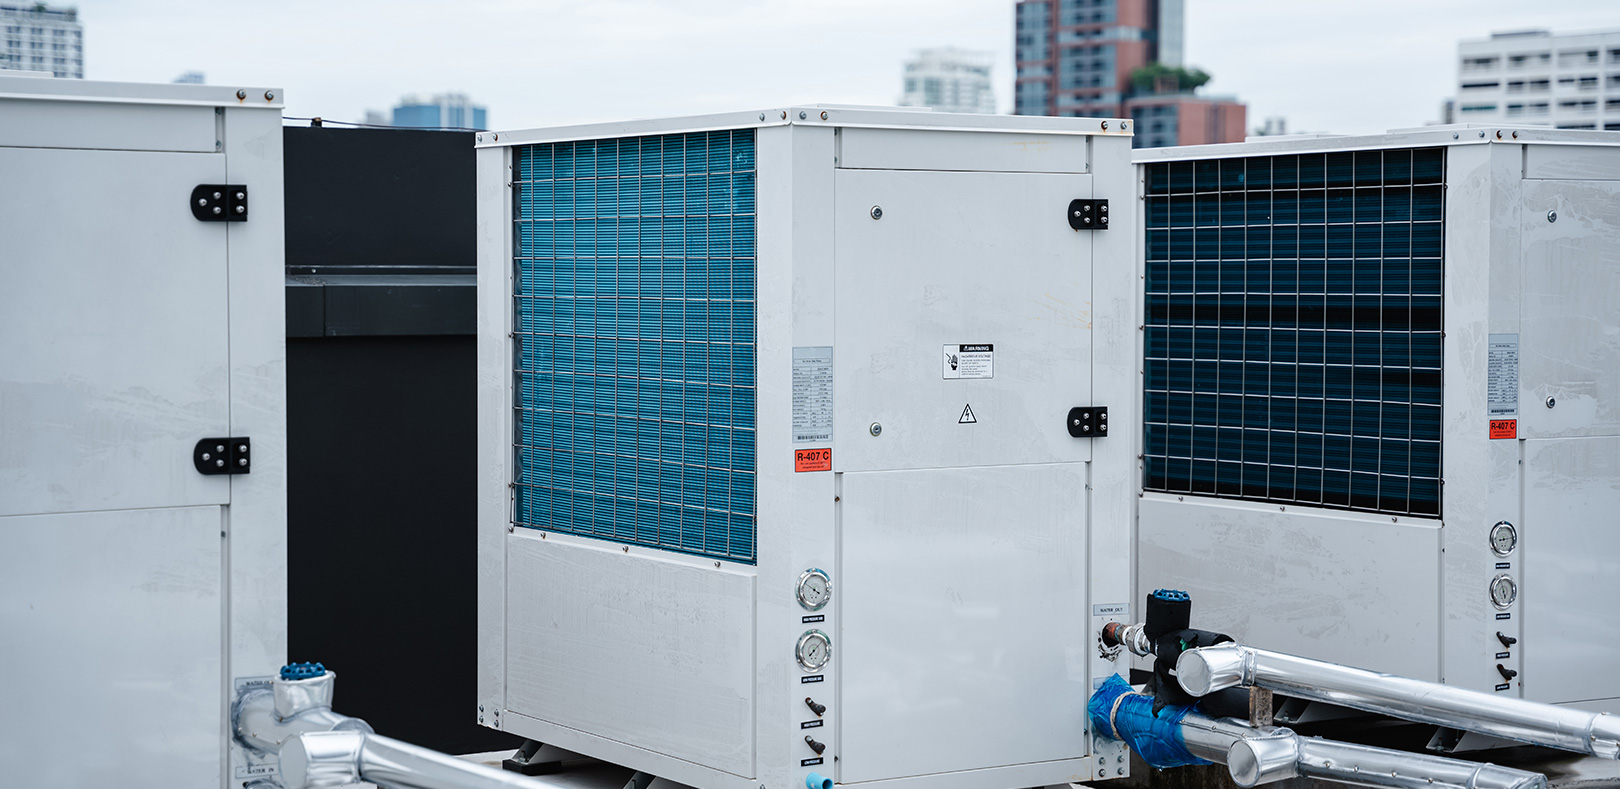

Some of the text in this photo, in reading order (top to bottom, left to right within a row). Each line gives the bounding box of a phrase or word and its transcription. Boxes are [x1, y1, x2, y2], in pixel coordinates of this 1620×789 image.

[1491, 422, 1515, 430] R-407 C
[797, 451, 829, 461] R-407 C
